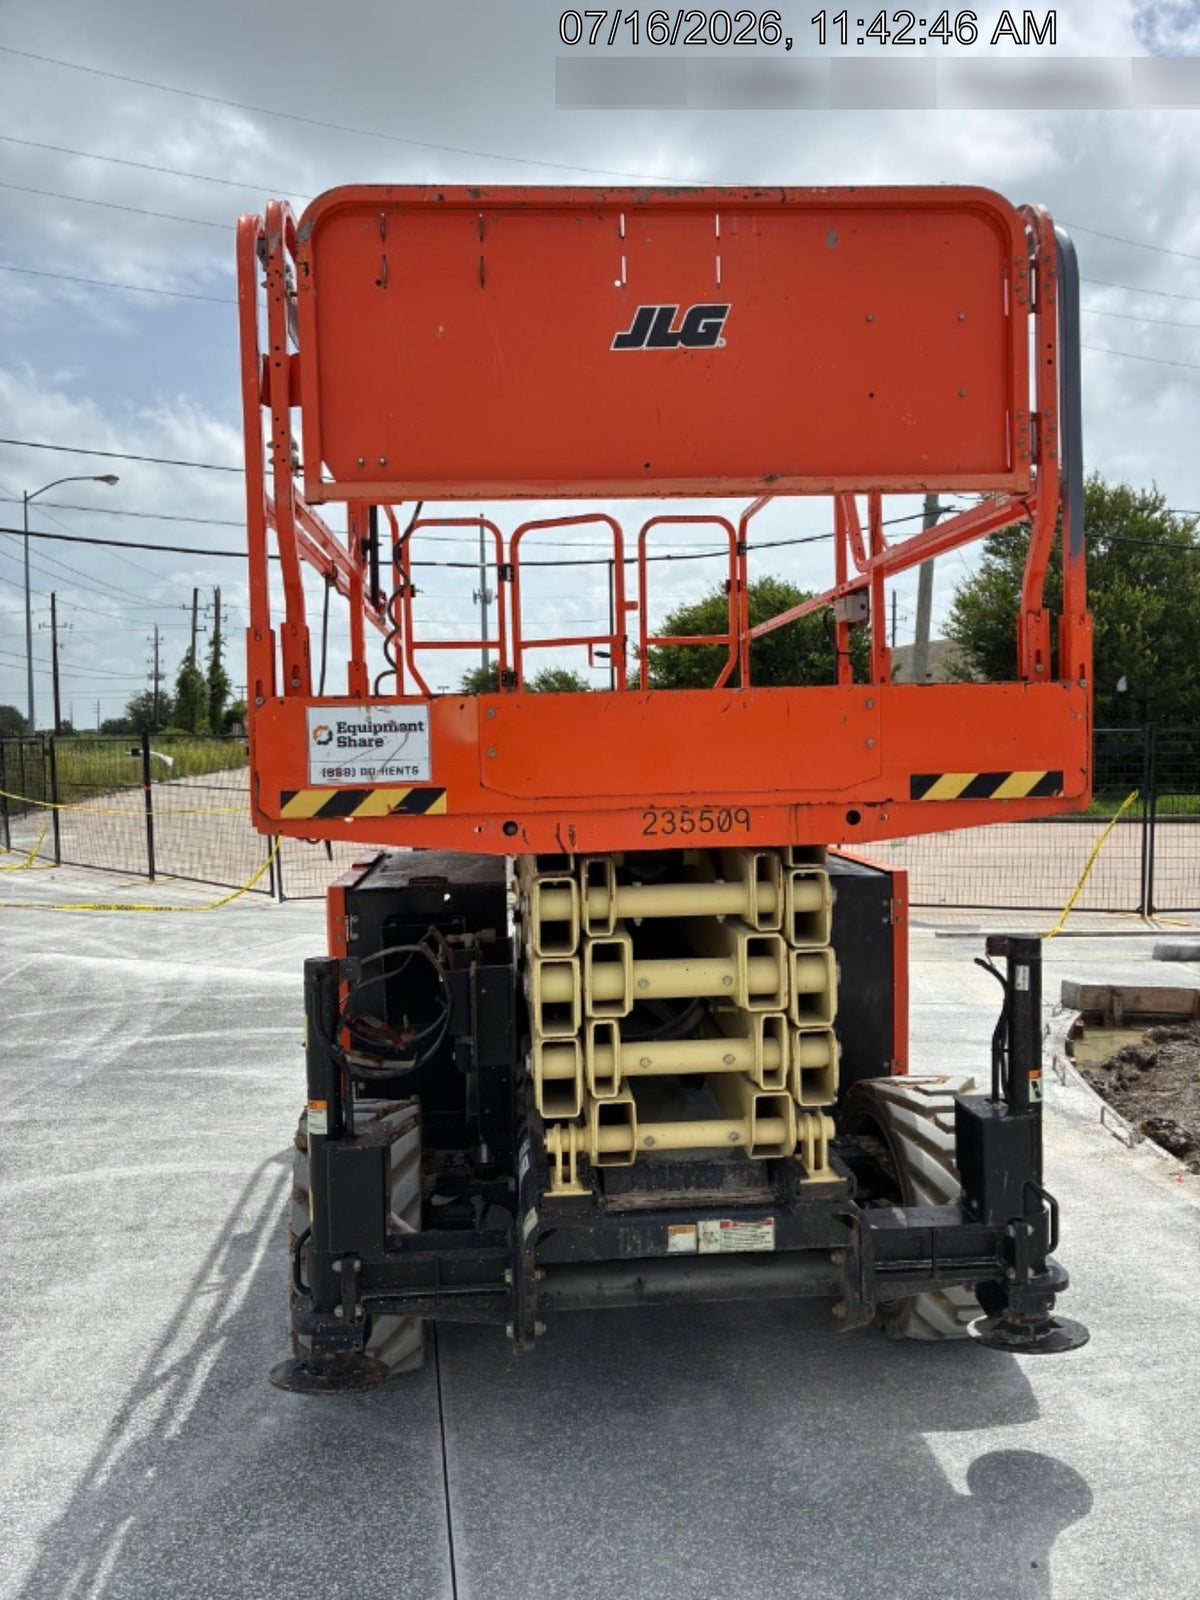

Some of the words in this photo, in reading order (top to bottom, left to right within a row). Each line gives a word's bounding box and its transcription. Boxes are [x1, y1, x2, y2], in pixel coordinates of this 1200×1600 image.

[610, 303, 732, 351] JLG
[337, 735, 384, 749] Share
[642, 807, 751, 836] 235509
